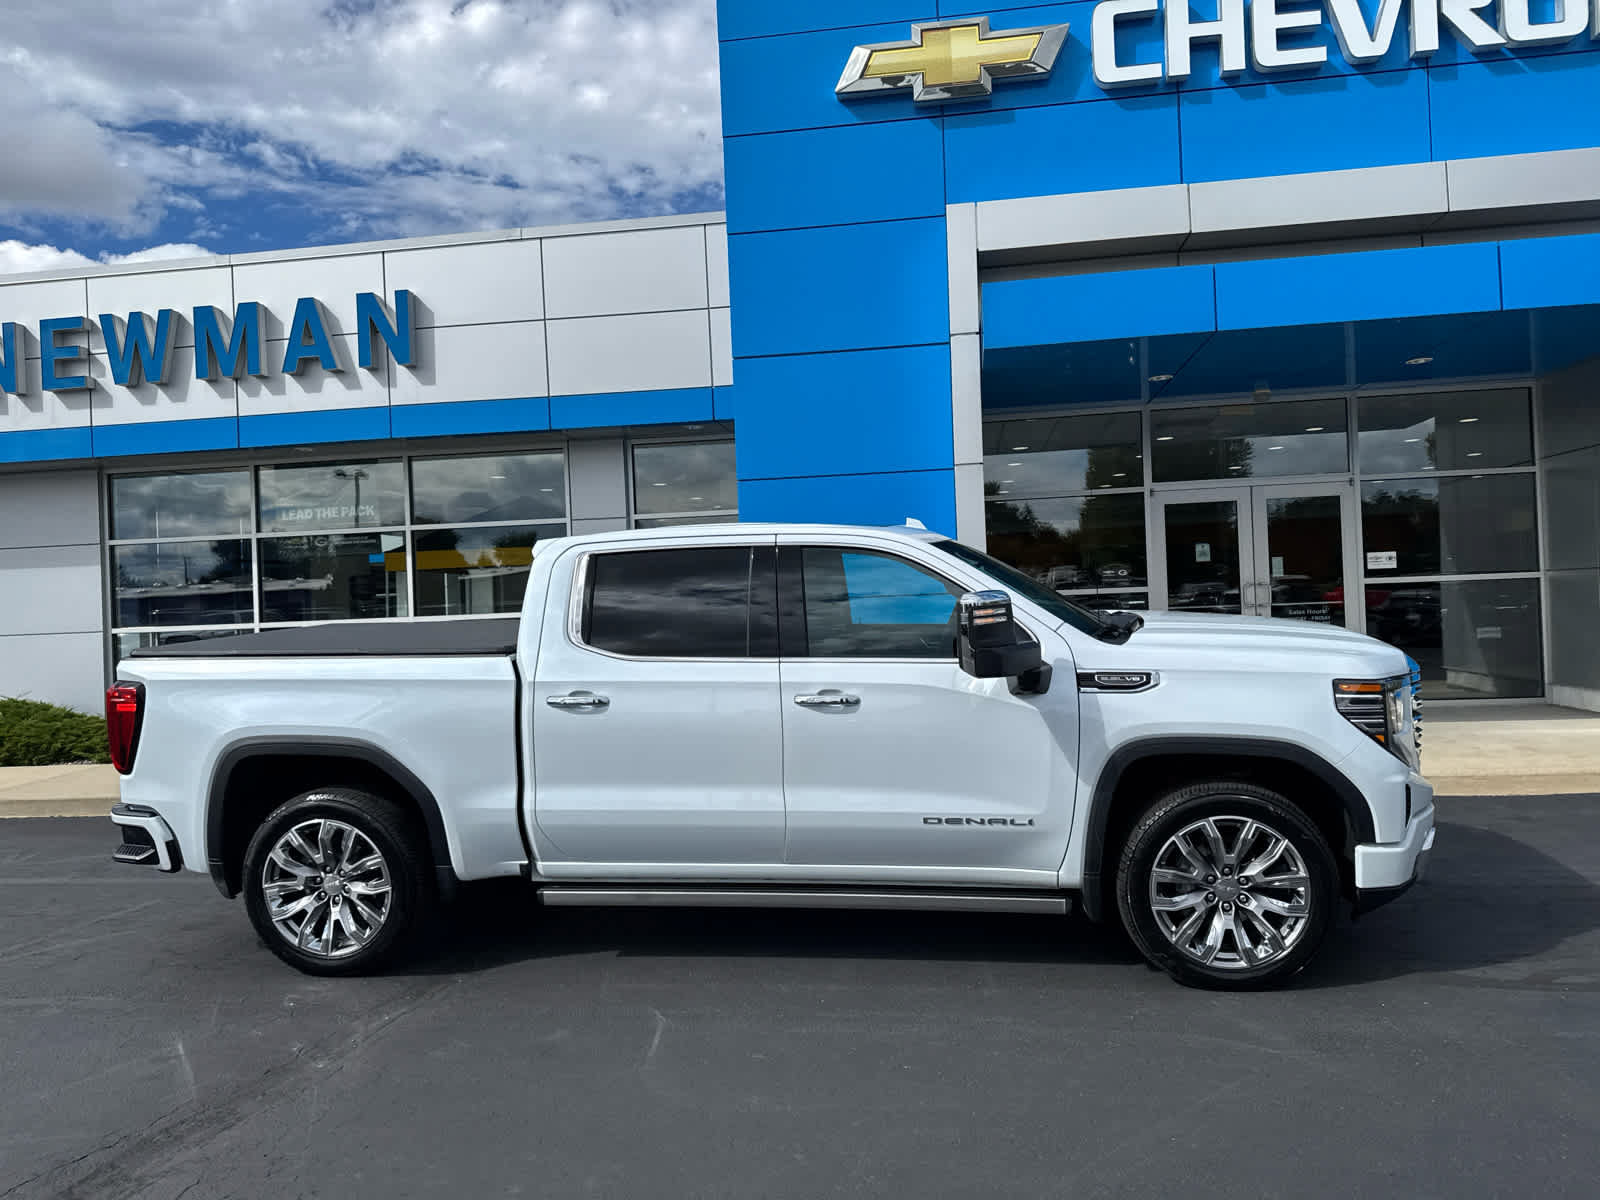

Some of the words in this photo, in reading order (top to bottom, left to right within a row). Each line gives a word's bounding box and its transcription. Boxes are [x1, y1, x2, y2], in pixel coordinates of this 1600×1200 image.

[1091, 0, 1600, 89] CHEVR
[282, 508, 313, 521] LEAD
[315, 506, 339, 519] THE
[341, 504, 375, 517] PACK
[922, 816, 1036, 826] DENALI
